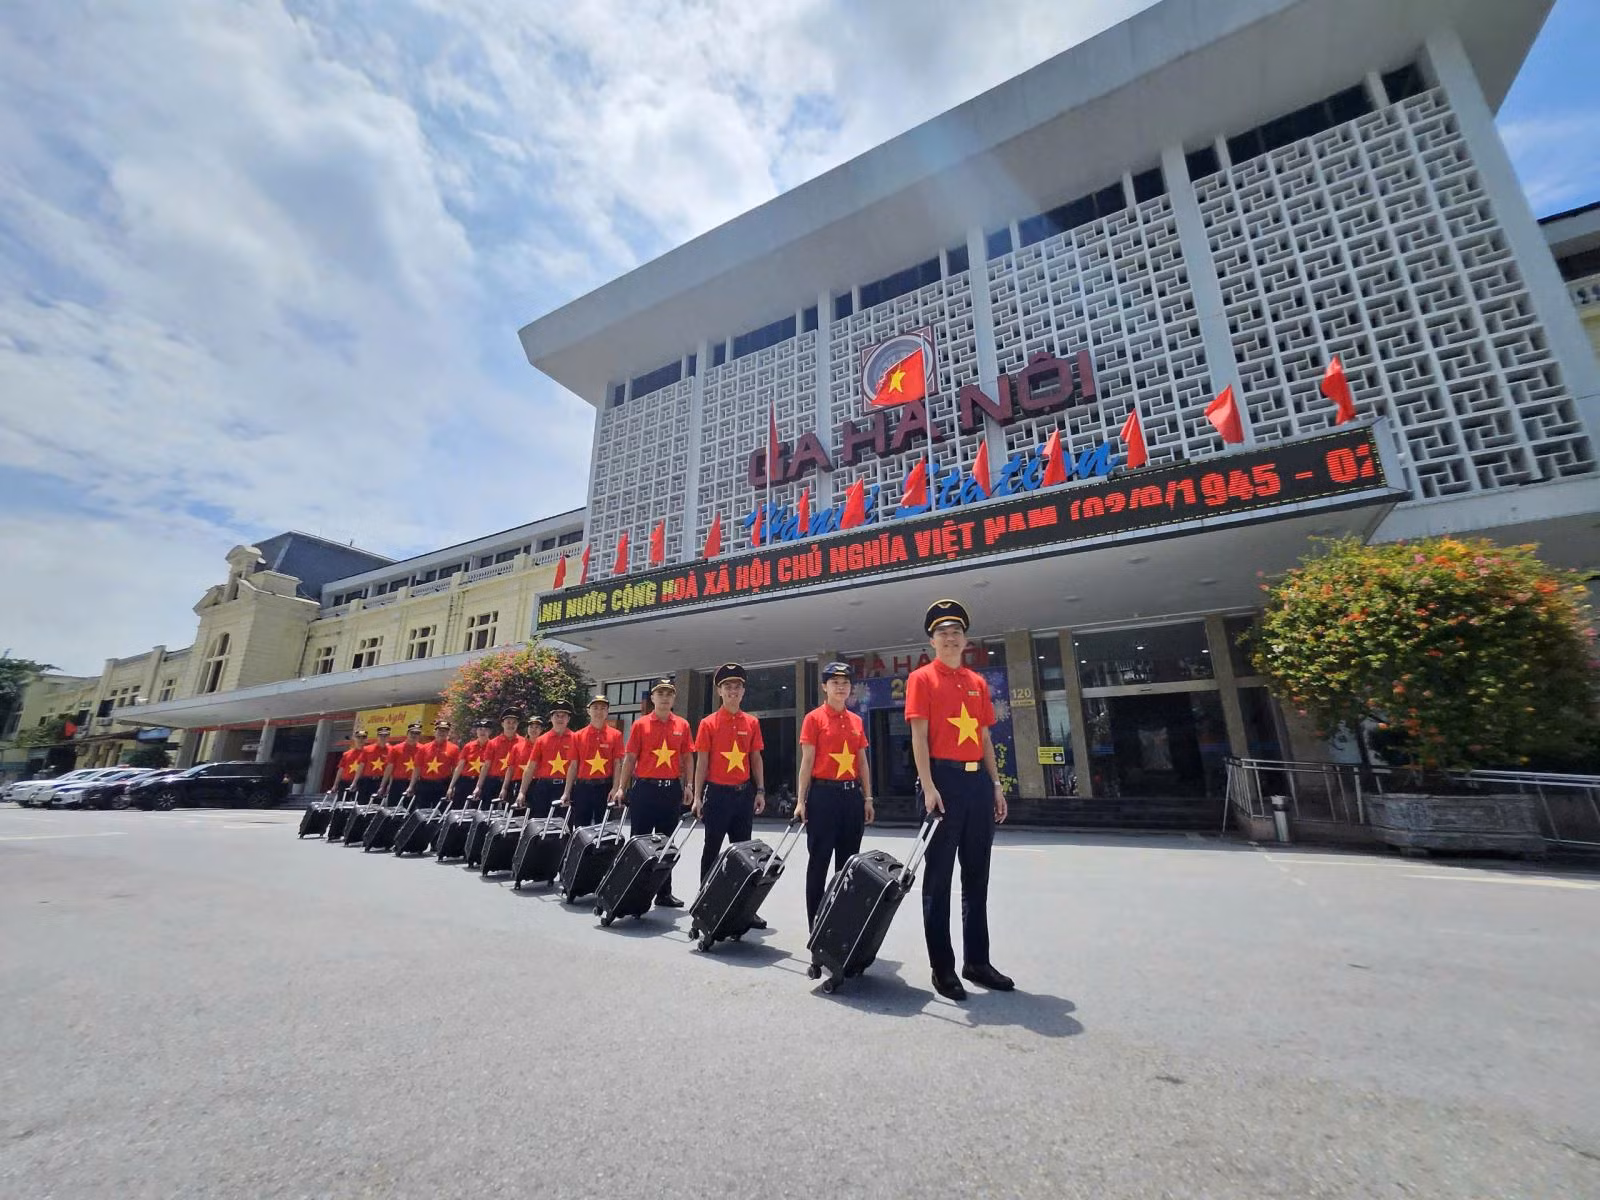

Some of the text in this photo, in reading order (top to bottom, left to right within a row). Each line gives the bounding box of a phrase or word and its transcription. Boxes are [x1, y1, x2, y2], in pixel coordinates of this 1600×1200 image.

[960, 349, 1097, 430] NỘI
[565, 591, 607, 618] NƯỚC
[611, 582, 656, 613] CỘNG
[703, 564, 730, 596] XÃ
[735, 557, 771, 593] HỘI
[777, 544, 823, 583] CHỦ
[829, 532, 908, 574] NGHĨA
[914, 520, 975, 560] VIỆT
[983, 505, 1058, 545] NAM
[1295, 470, 1313, 480] -
[1012, 688, 1031, 699] 120
